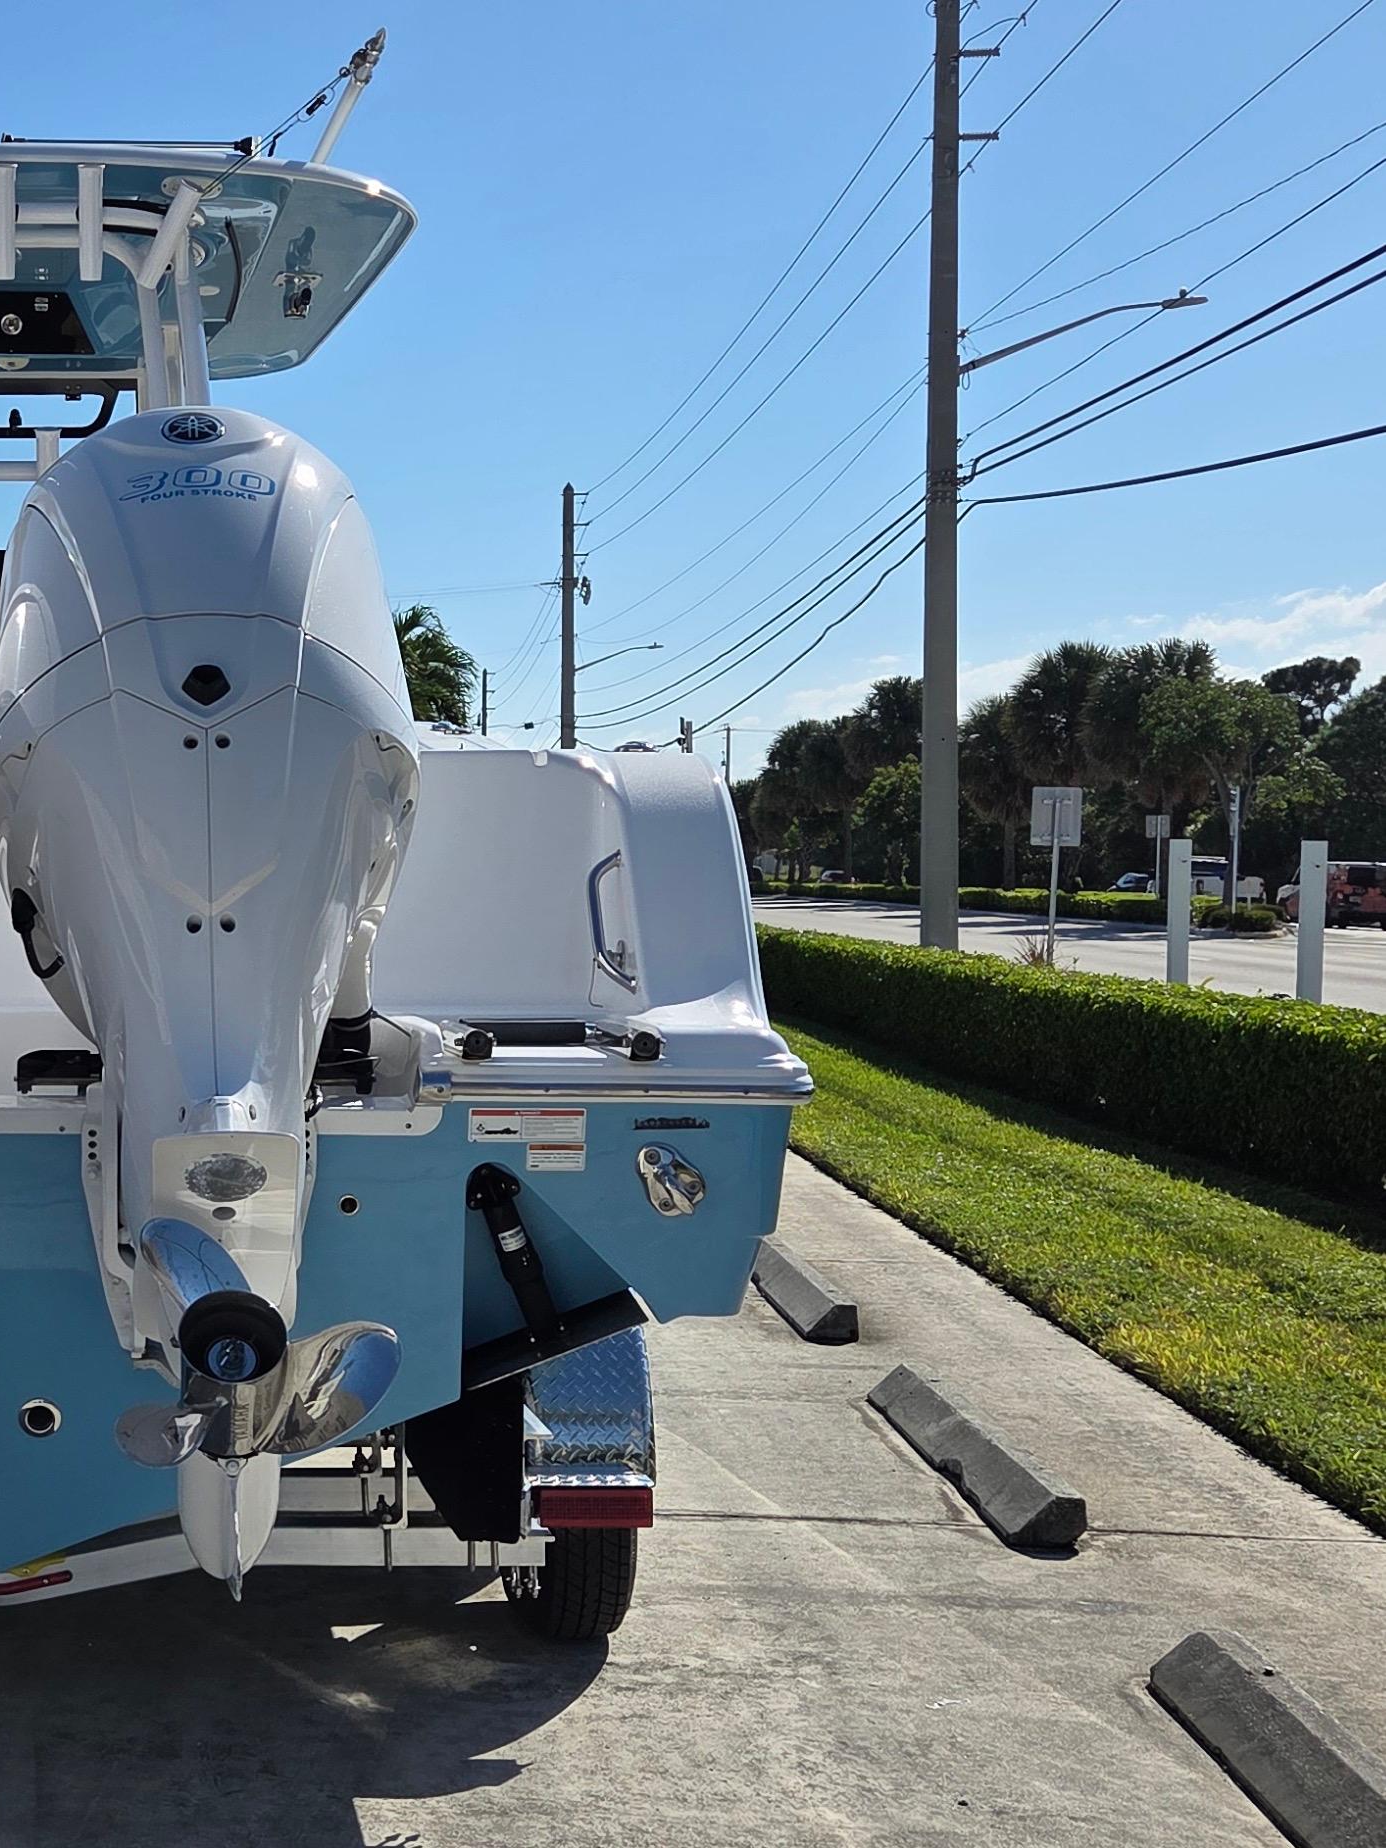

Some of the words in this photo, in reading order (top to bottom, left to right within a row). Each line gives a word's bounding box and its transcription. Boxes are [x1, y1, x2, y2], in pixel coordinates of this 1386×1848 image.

[119, 465, 276, 502] 300
[140, 489, 185, 504] FOUR
[190, 488, 257, 502] STROKE
